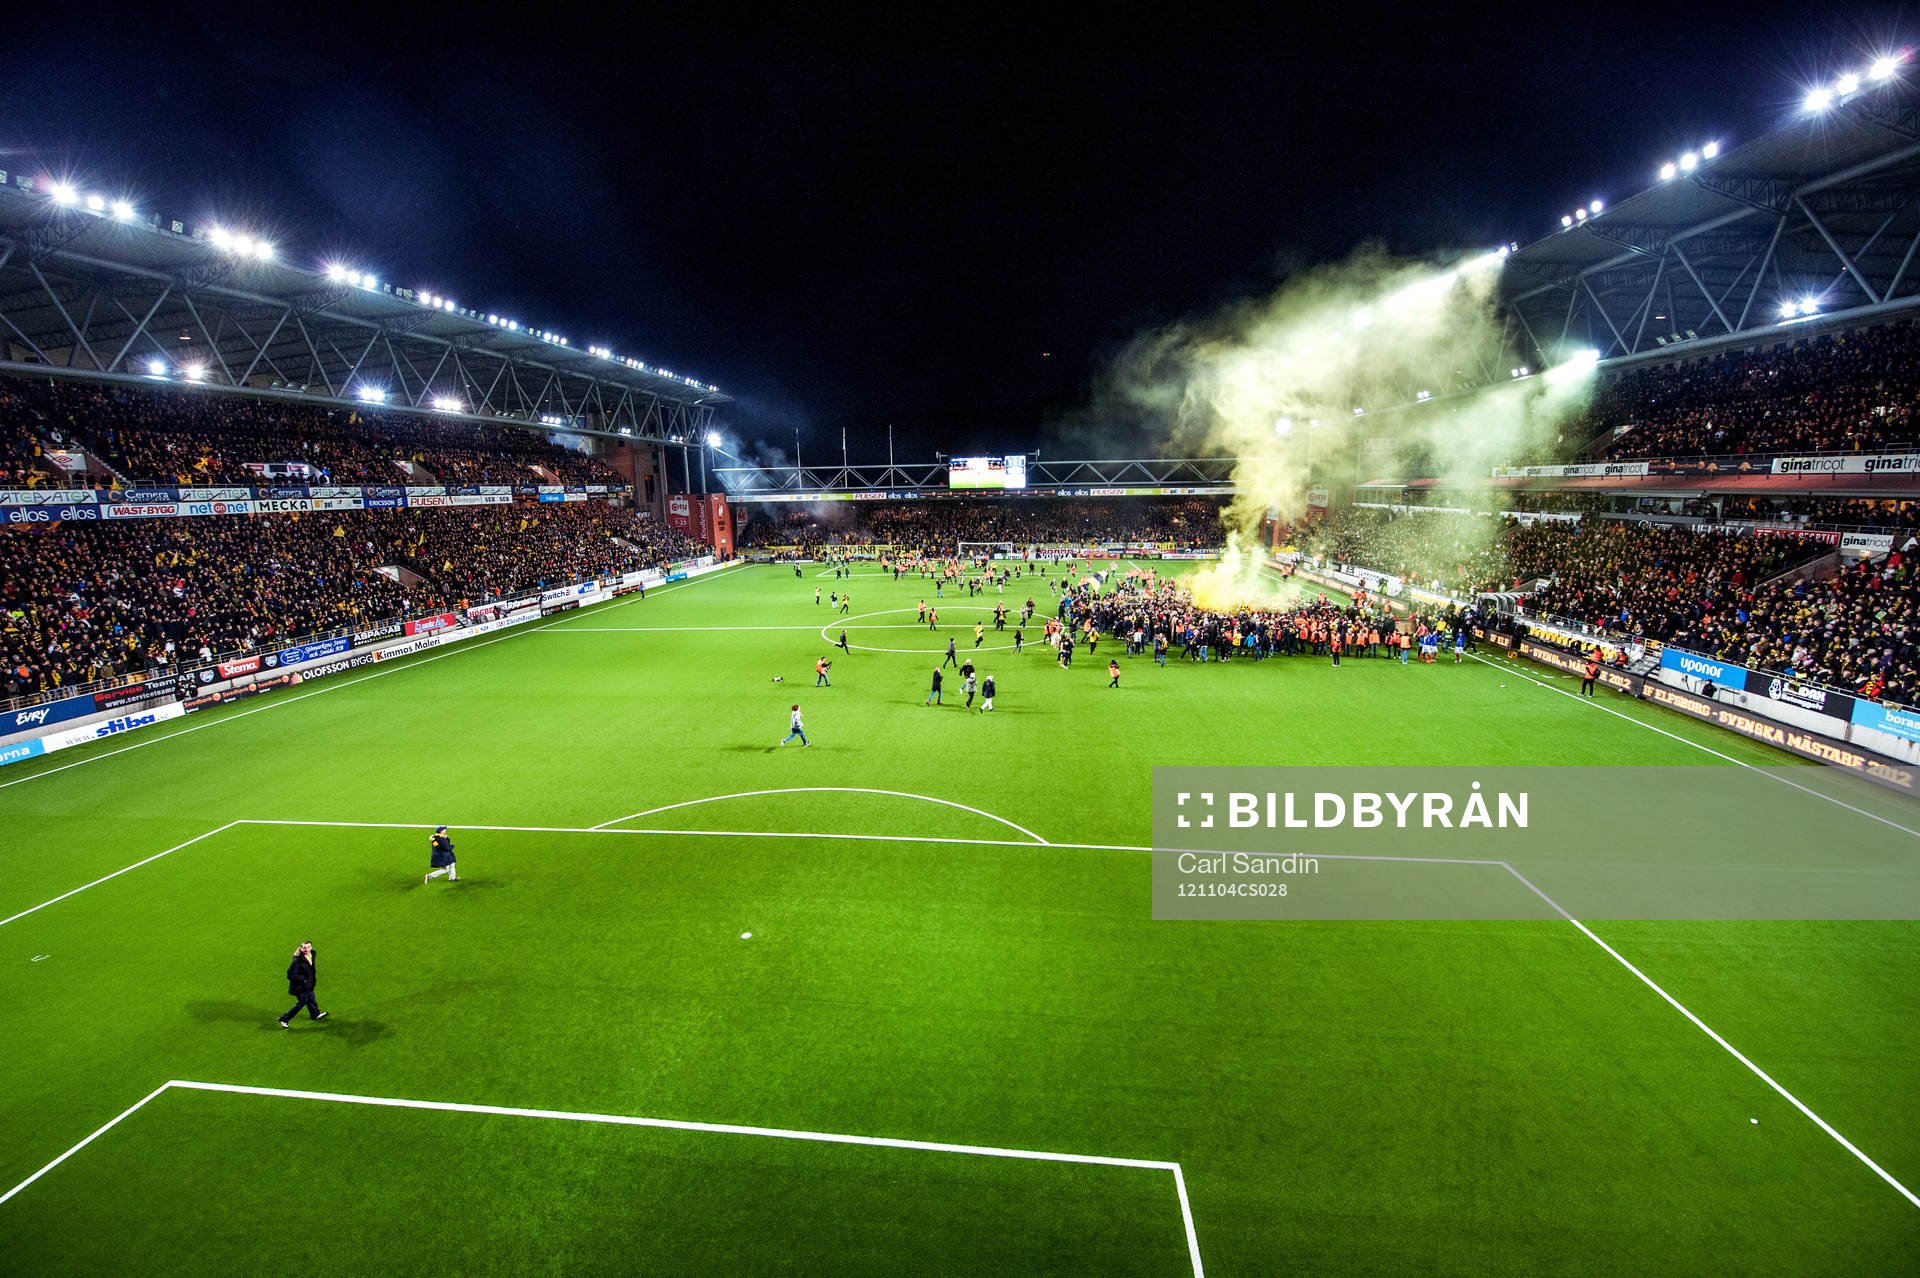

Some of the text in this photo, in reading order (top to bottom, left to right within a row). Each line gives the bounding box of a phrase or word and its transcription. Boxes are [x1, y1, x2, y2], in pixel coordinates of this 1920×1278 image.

[1563, 465, 1596, 476] ginatricot
[1605, 464, 1643, 475] ginatricot
[1781, 457, 1845, 472] ginatricot
[259, 500, 308, 512] MECKA
[410, 497, 445, 506] PULSEN
[10, 505, 96, 522] ellos ellos
[1843, 536, 1892, 548] ginatricot
[542, 590, 566, 602] Switch
[376, 645, 413, 661] Kimmos
[303, 655, 373, 680] OLOFSSON BYGG
[1680, 657, 1724, 678] uponor
[1609, 673, 1632, 690] 2012
[94, 685, 143, 702] Service
[144, 678, 176, 690] Team
[1642, 684, 1655, 697] IF
[1654, 688, 1712, 717] ELFSBORG
[1719, 711, 1784, 744] SVENSKA
[1866, 760, 1914, 788] 2012
